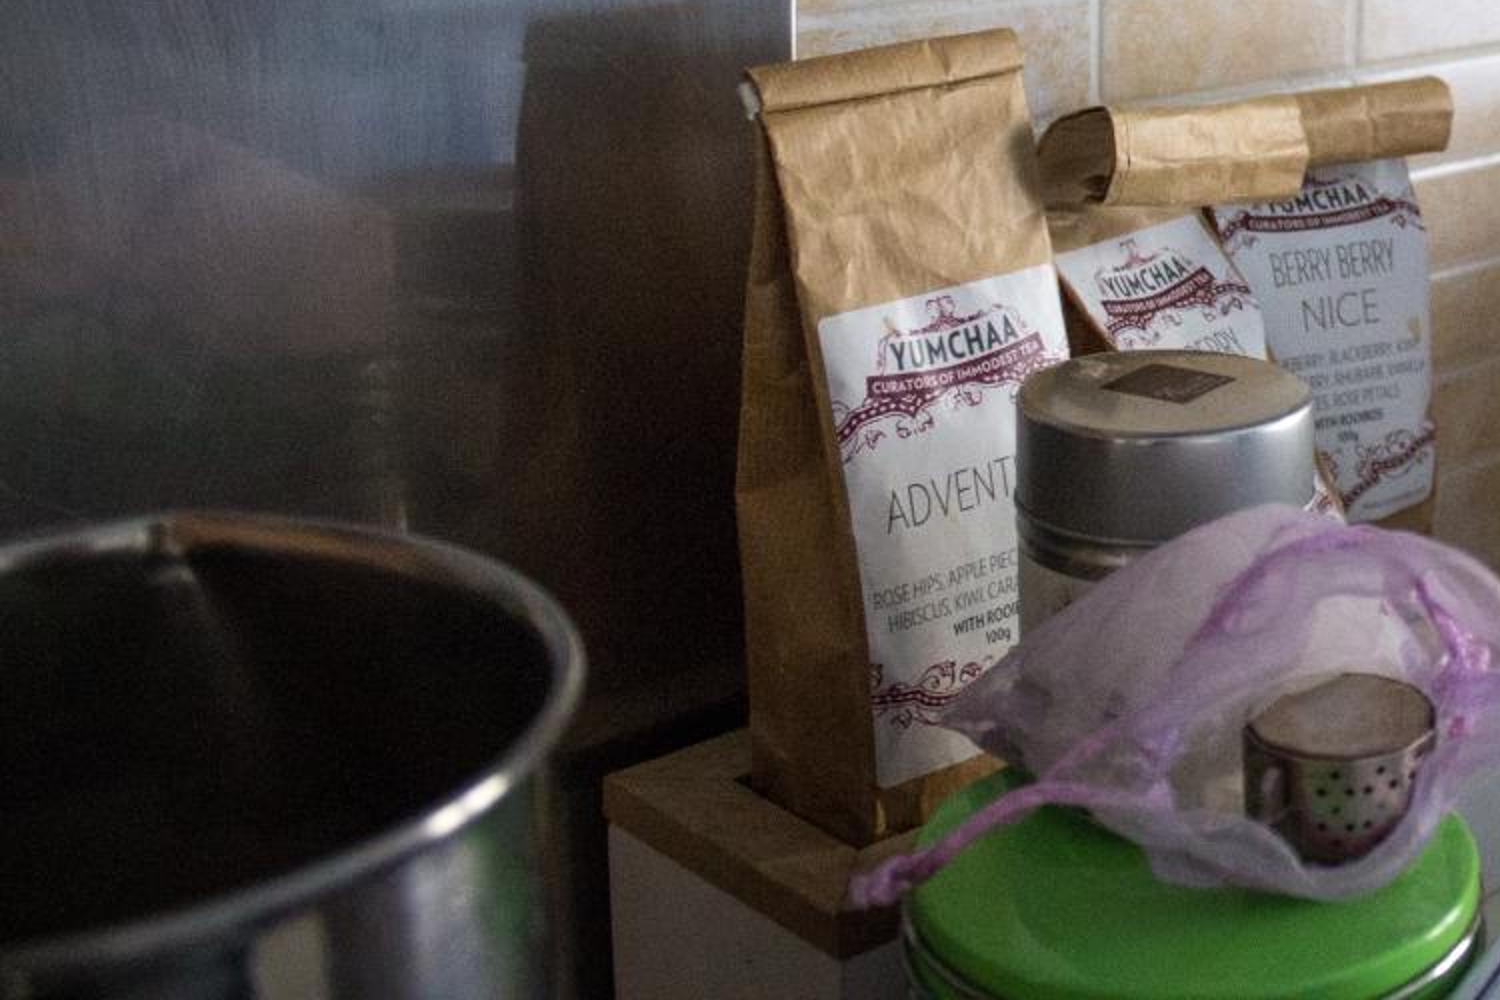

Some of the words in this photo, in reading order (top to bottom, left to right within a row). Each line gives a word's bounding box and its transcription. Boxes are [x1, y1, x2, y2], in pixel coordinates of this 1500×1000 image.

[1101, 254, 1190, 299] YUMCHAA
[1268, 247, 1330, 289] BERRY
[1334, 238, 1394, 280] BERRY
[1301, 288, 1380, 333] NICE
[889, 314, 1019, 371] YUMCHAA
[871, 374, 938, 395] CURATORS
[939, 370, 955, 386] OF
[956, 349, 1018, 381] IMMODEST
[1018, 340, 1040, 357] TEA
[887, 454, 1011, 536] ADVENT
[949, 556, 988, 586] APPLE
[953, 615, 985, 638] WITH
